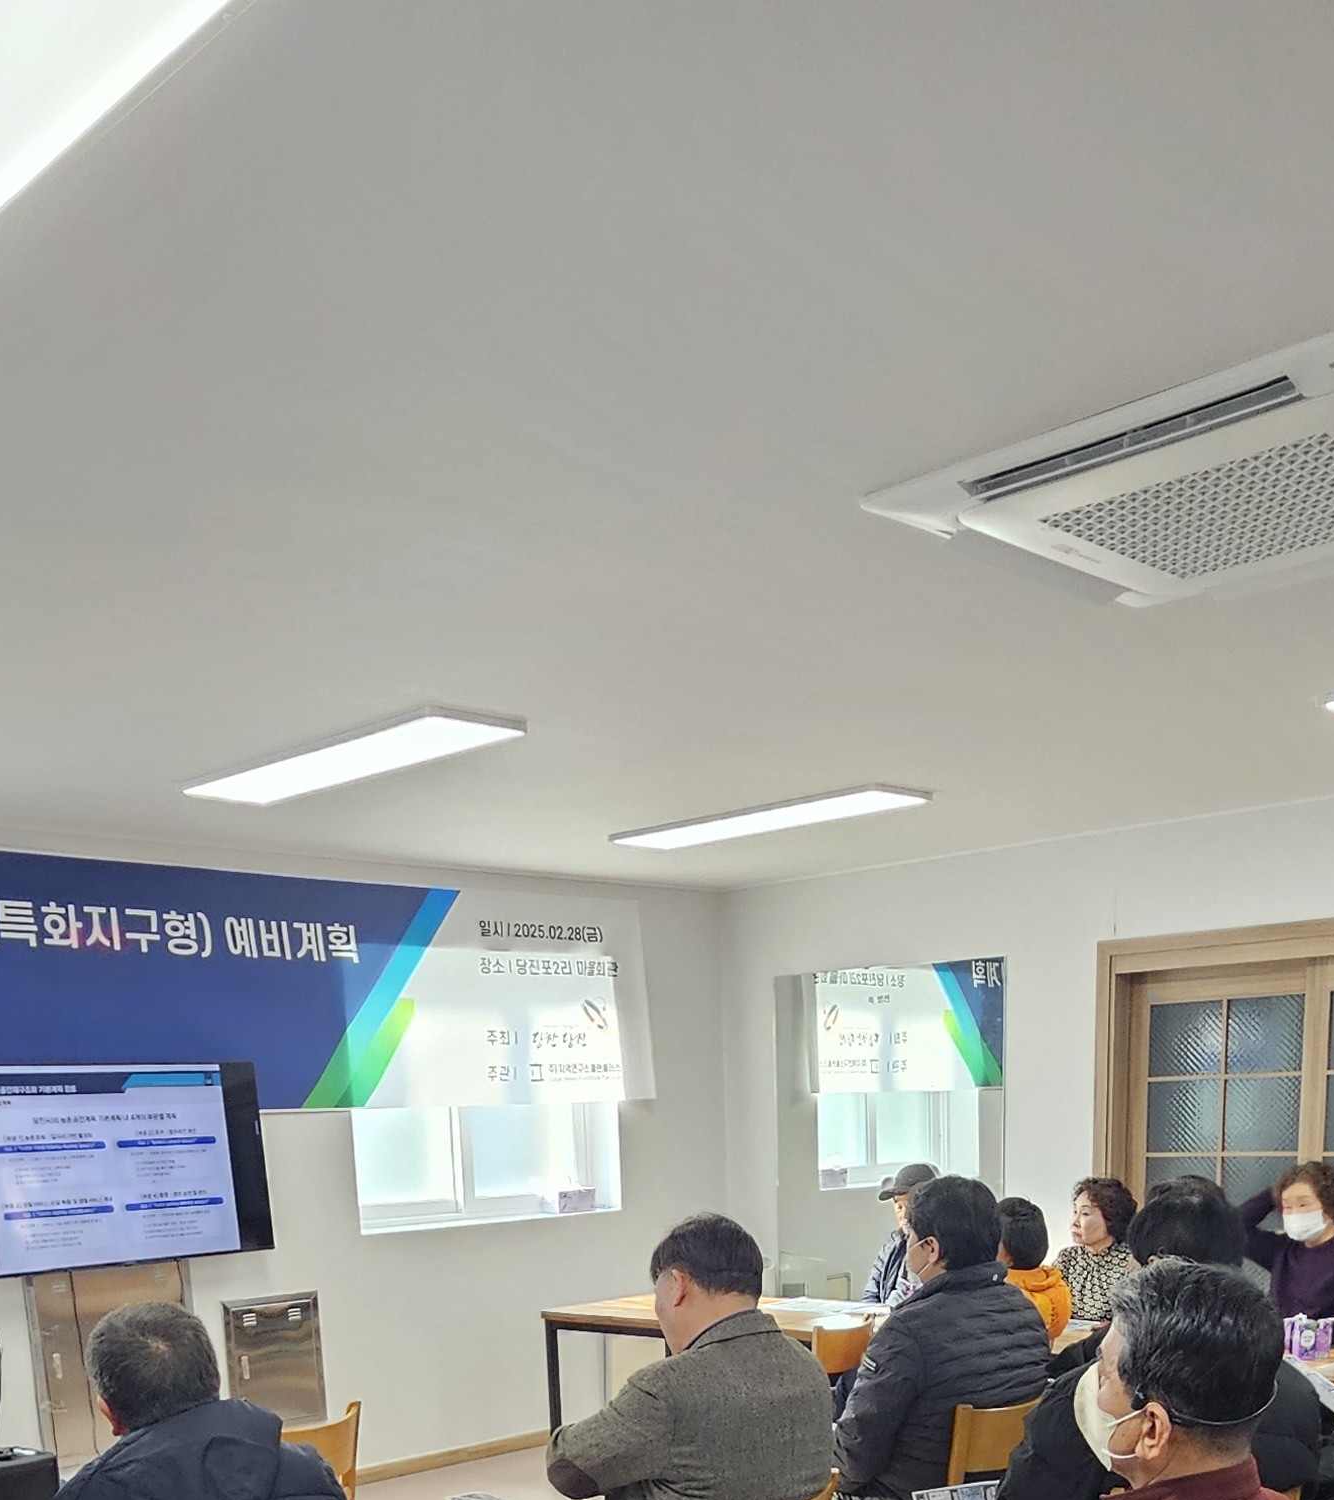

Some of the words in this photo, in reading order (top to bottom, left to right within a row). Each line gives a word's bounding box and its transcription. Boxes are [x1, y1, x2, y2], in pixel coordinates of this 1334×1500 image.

[227, 917, 359, 964] 예비계획
[479, 920, 504, 937] 일시
[514, 923, 603, 943] 2025.02.28(금)
[480, 957, 505, 974] 장소
[516, 959, 573, 975] 당진포2리
[487, 1030, 509, 1045] 주최
[487, 1066, 510, 1082] 주관
